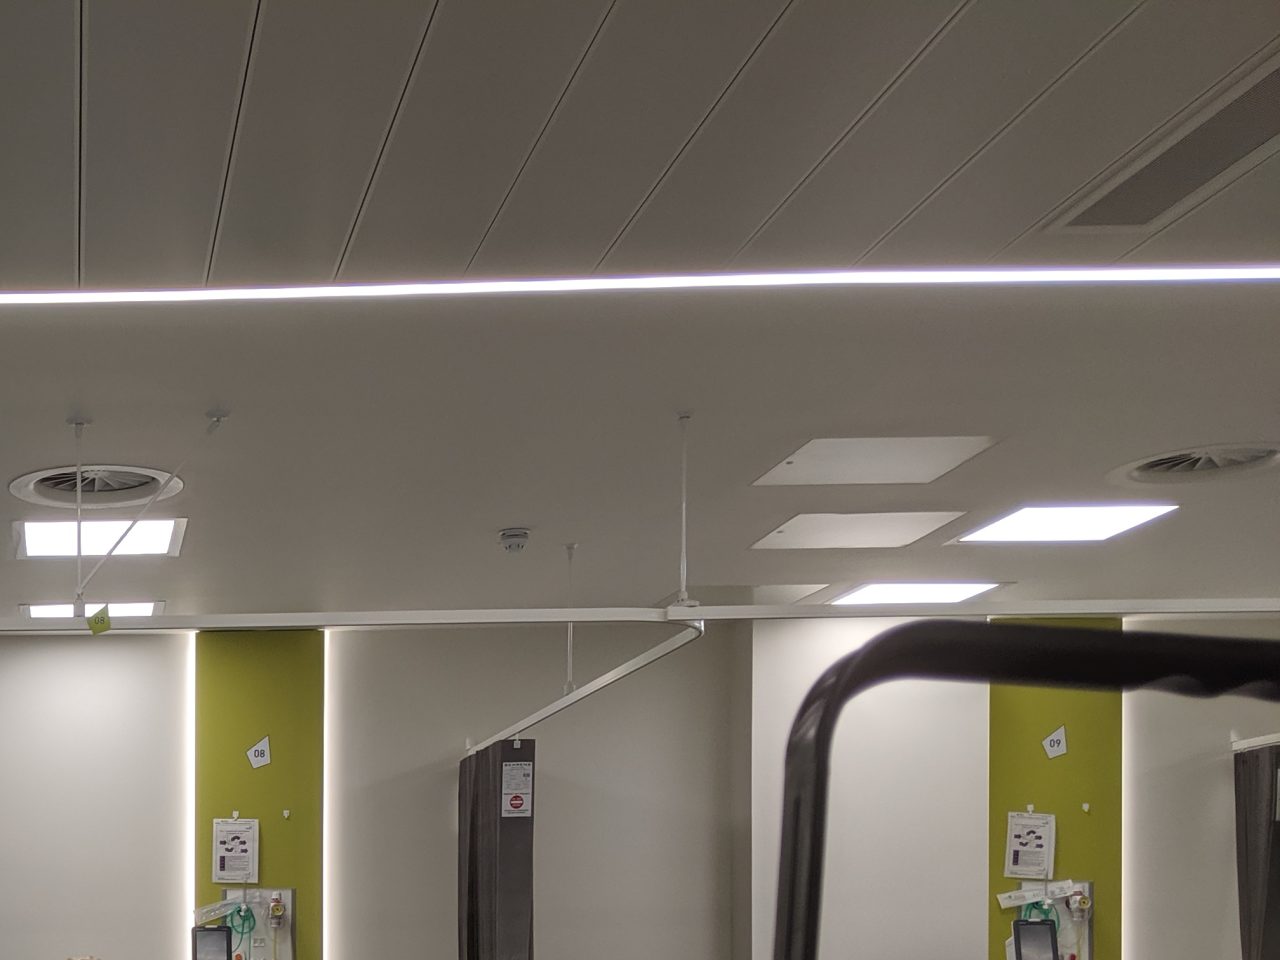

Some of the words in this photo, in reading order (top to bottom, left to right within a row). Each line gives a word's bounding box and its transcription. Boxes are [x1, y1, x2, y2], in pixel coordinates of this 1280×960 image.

[95, 616, 105, 625] 08
[1049, 738, 1062, 748] 09
[253, 749, 266, 758] 08
